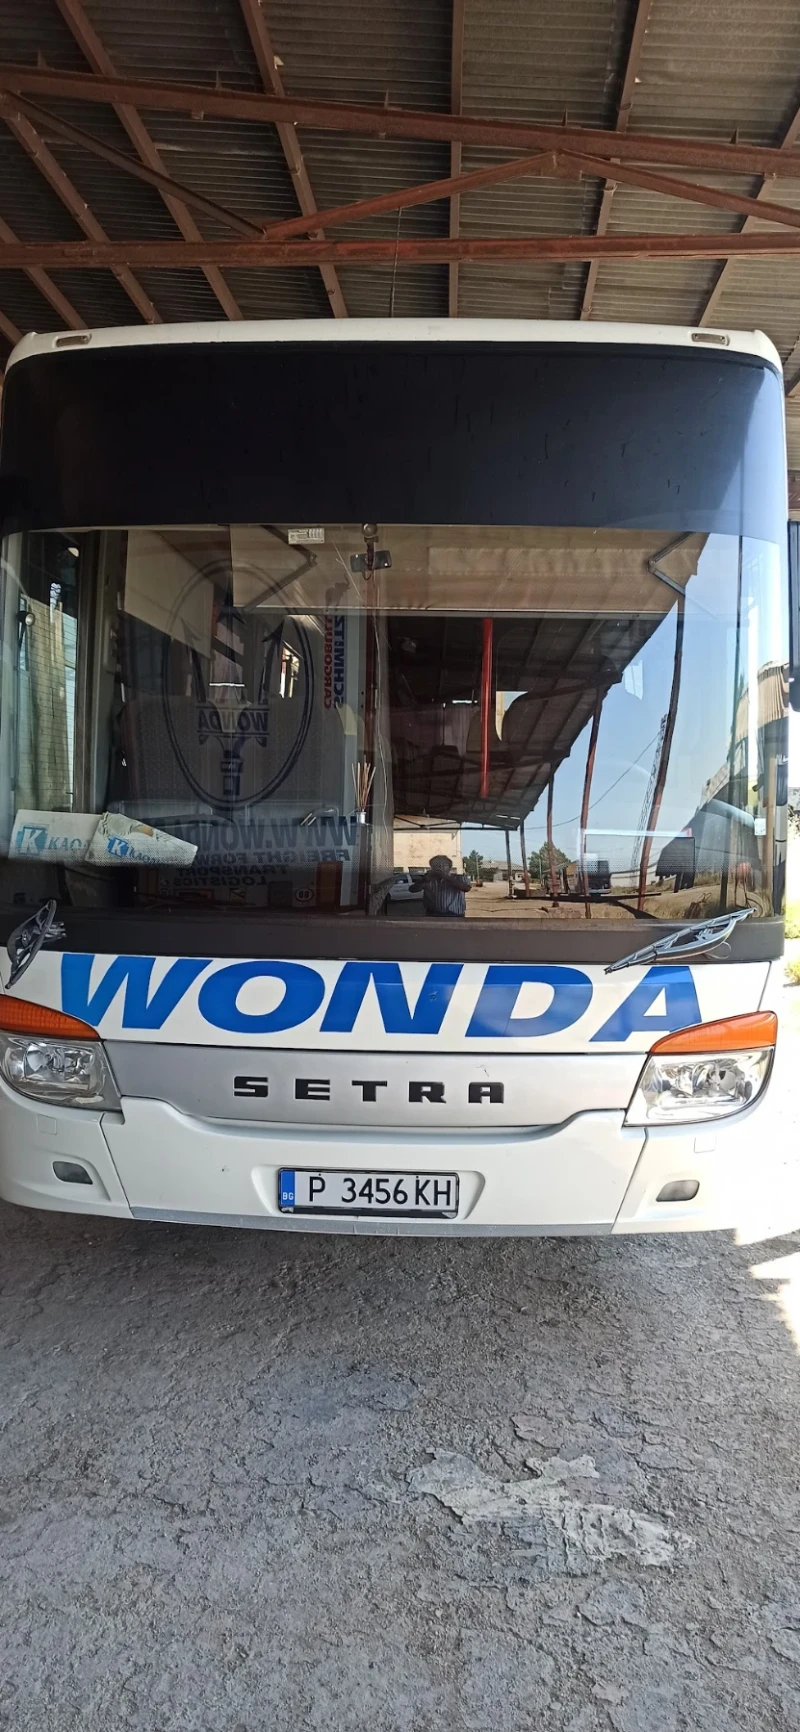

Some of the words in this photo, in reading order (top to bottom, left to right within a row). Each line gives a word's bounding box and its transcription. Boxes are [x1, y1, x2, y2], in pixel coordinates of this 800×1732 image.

[60, 953, 702, 1043] WONDA
[233, 1075, 505, 1104] SETRA
[282, 1192, 294, 1201] BG
[341, 1177, 408, 1205] 3456
